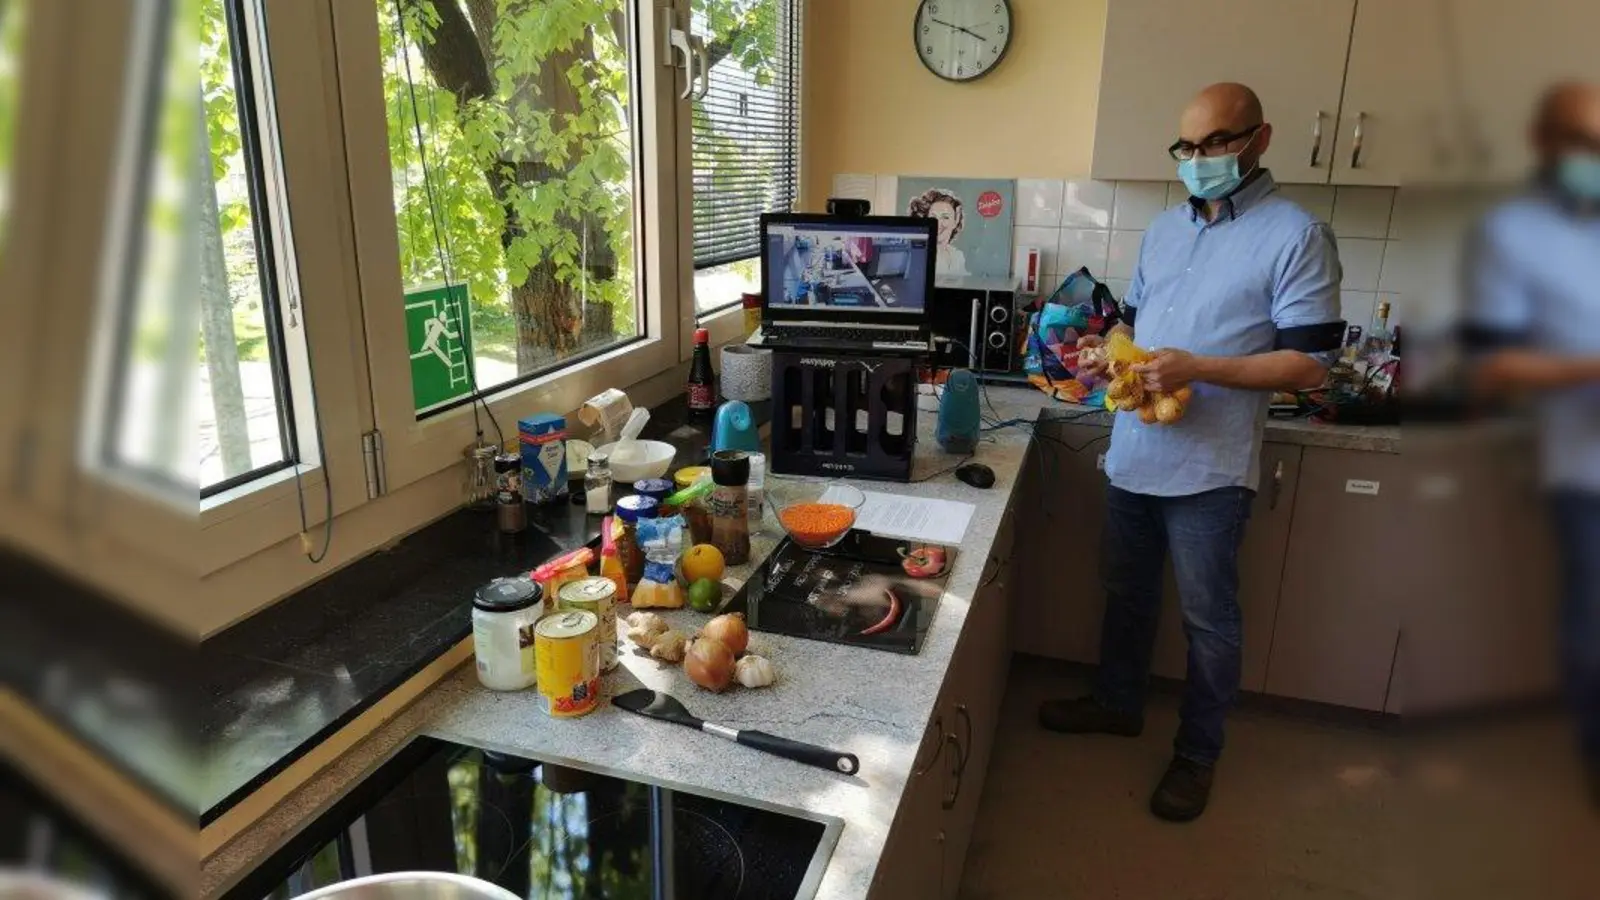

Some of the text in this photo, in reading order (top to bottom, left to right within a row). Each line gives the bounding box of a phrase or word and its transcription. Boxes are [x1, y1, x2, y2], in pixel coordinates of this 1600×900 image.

[928, 4, 938, 15] 10
[992, 4, 1001, 13] 2
[923, 25, 929, 34] 9
[997, 25, 1004, 34] 3
[926, 46, 933, 54] 8
[992, 45, 998, 54] 4
[977, 61, 982, 69] 5
